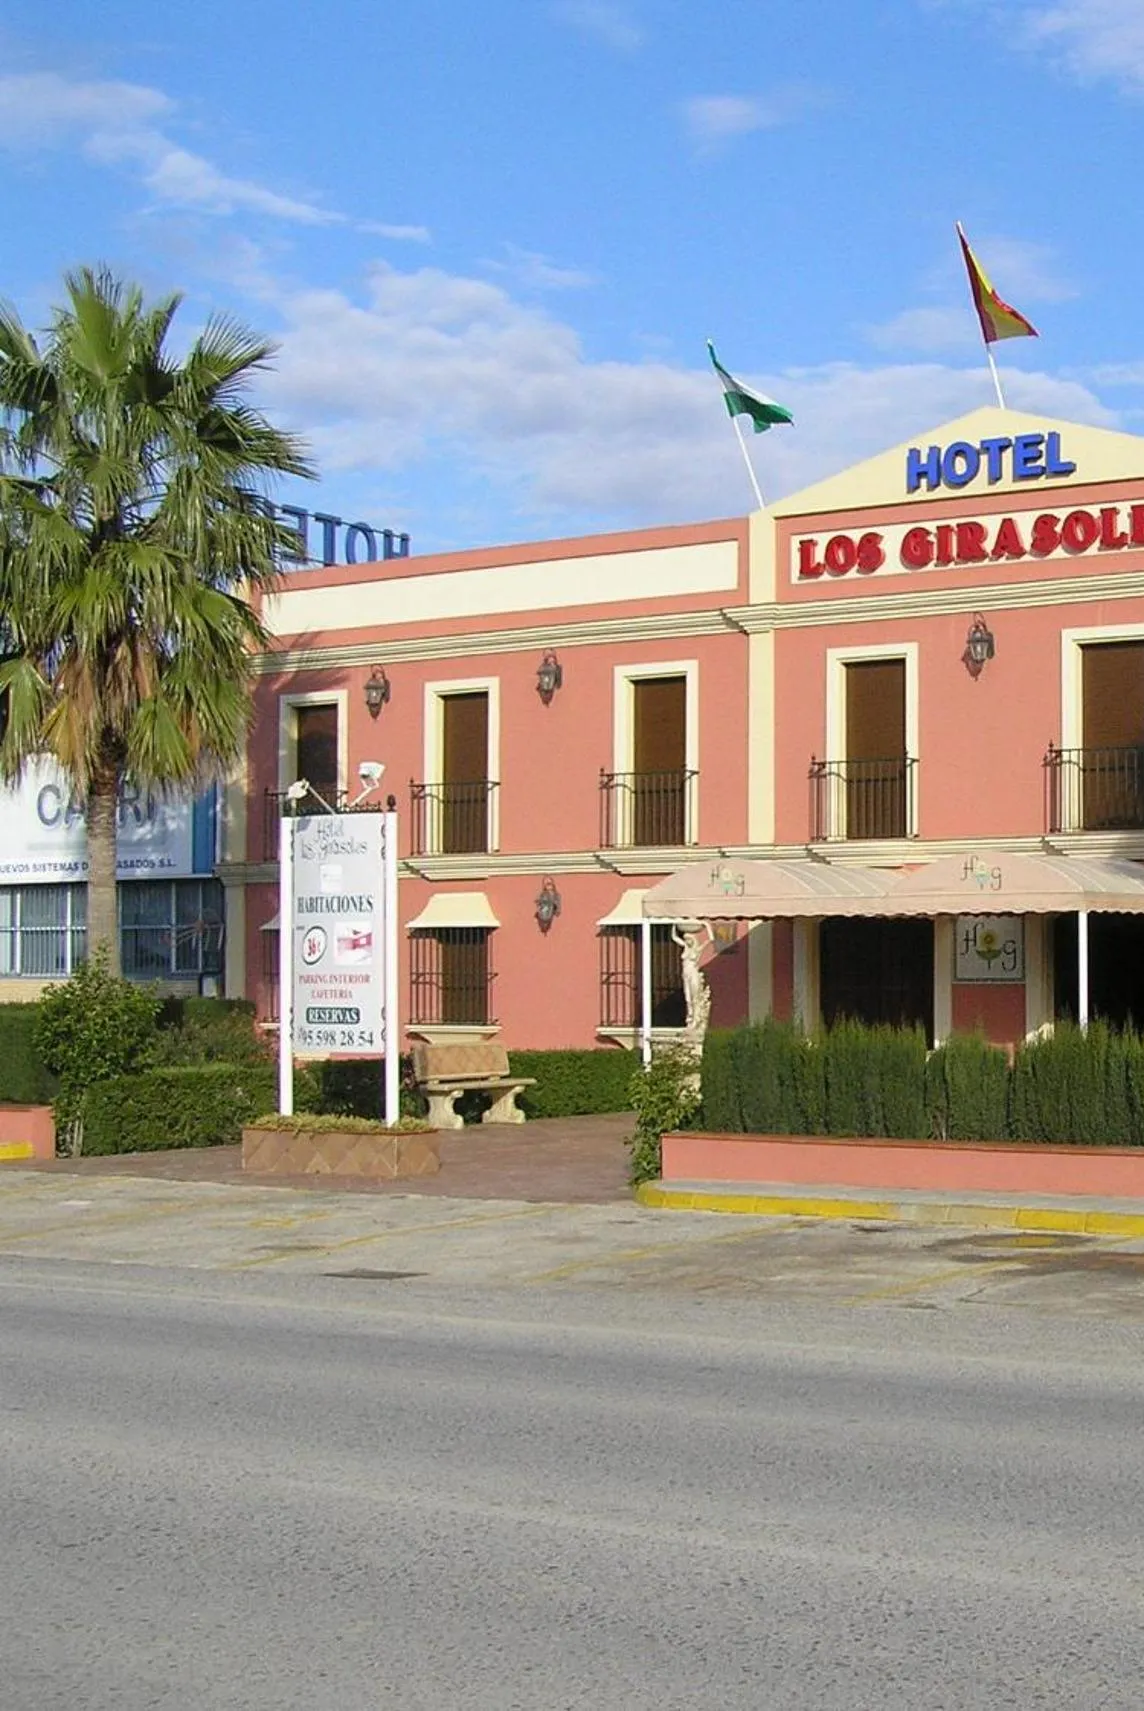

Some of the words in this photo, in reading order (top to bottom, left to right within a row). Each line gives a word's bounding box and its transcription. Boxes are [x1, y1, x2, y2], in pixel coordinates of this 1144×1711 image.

[907, 431, 1077, 494] HOTEL
[798, 532, 885, 580] LOS
[297, 894, 374, 914] HABITACIONES
[299, 974, 326, 985] PARKING
[328, 973, 371, 984] INTERIOR
[309, 1008, 358, 1022] RESERVAS
[316, 1029, 336, 1047] 598
[340, 1029, 355, 1047] 28
[358, 1029, 374, 1047] 54
